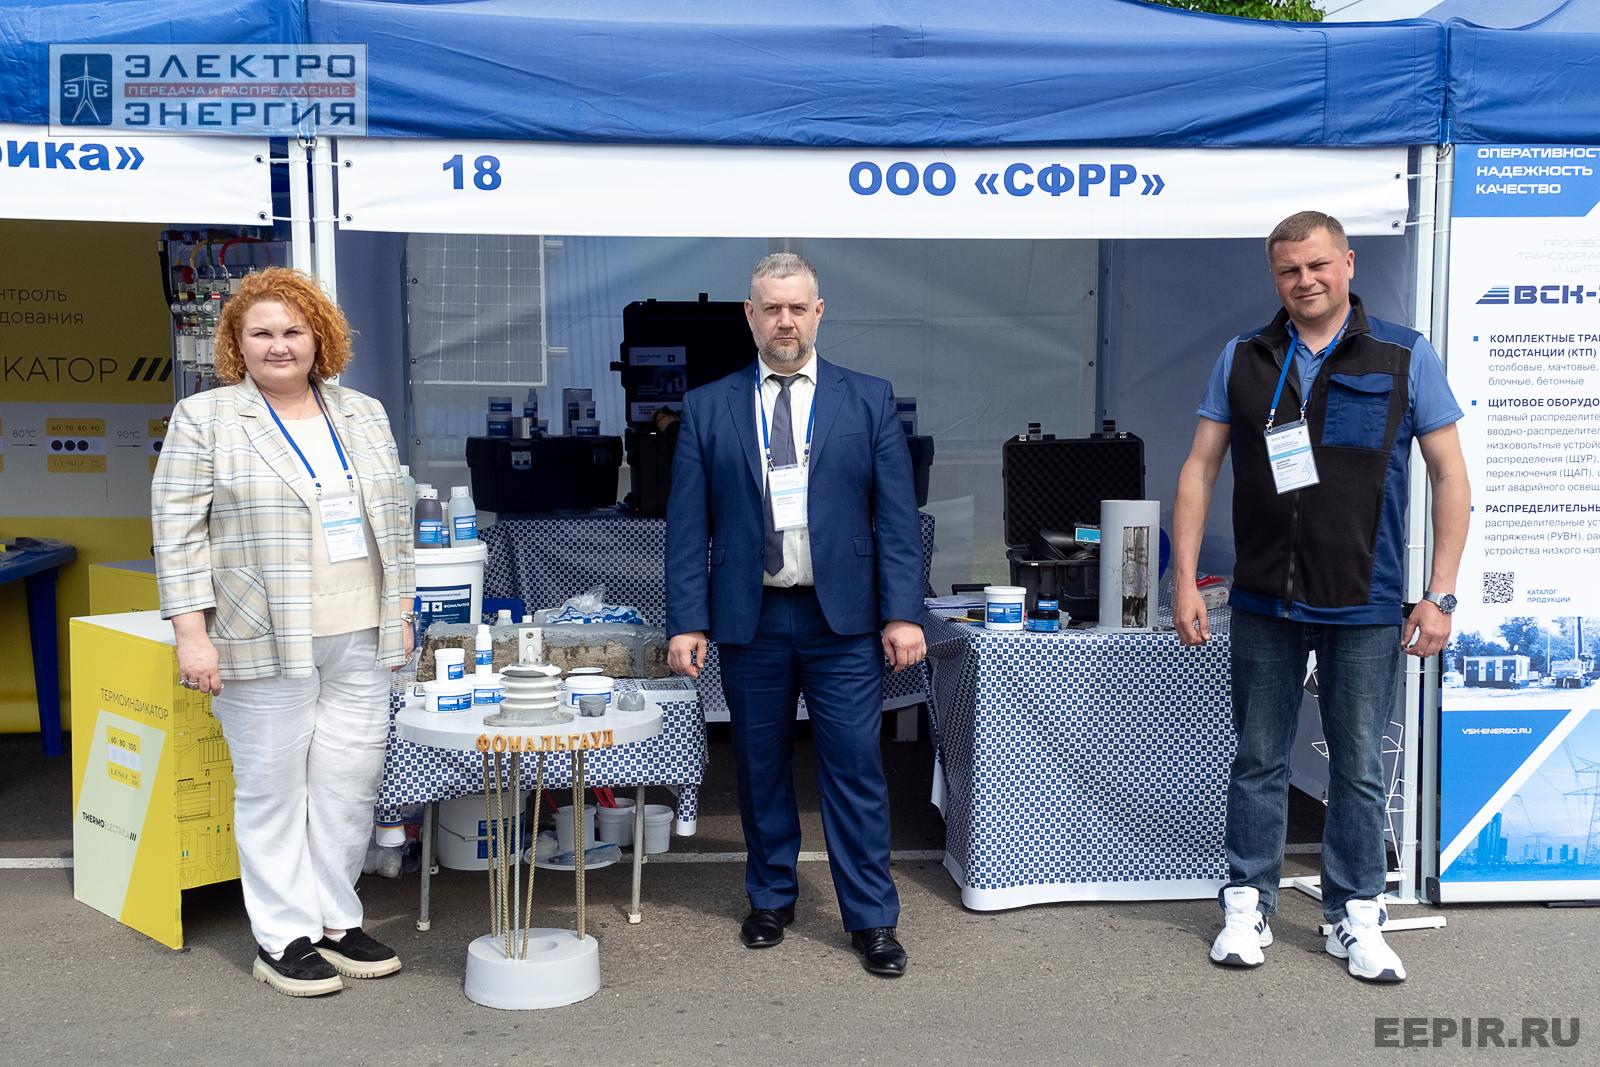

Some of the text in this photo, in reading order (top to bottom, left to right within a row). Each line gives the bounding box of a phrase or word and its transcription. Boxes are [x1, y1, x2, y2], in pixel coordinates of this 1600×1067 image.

[0, 140, 145, 171] ика»
[442, 155, 502, 191] 18
[1476, 165, 1593, 178] НАДЕЖНОСТЬ
[848, 161, 1166, 197] ООО «СФРР»
[1476, 183, 1561, 195] КАЧЕСТВО
[1514, 284, 1600, 304] ВСК-
[0, 311, 84, 326] дования
[1490, 334, 1600, 343] КОМПЛЕКТНЫЕ ТРА
[1489, 348, 1597, 358] ПОДСТАНЦИИ (КТП)
[4, 356, 118, 383] КАТОР
[1488, 363, 1599, 373] столбовые, мачтовые,
[1488, 376, 1584, 387] блочные, бетонные
[1488, 398, 1600, 408] ЩИТОВОЕ ОБОРУДО
[1487, 413, 1528, 422] главный
[1486, 441, 1561, 450] низковольтные
[1486, 455, 1563, 465] распределения
[1486, 469, 1557, 478] переключения
[1485, 484, 1505, 492] щит
[1507, 483, 1565, 492] аварийного
[1485, 519, 1585, 528] распределительные
[1484, 533, 1545, 542] напряжения
[1587, 533, 1600, 541] ра
[1484, 546, 1540, 556] устройства
[1542, 547, 1581, 555] низкого
[1526, 596, 1571, 604] ПРОДУКЦИИ
[100, 688, 169, 720] ТЕРМОИНДИКАТОР
[1461, 727, 1532, 735] VSK-ENERGO.RU
